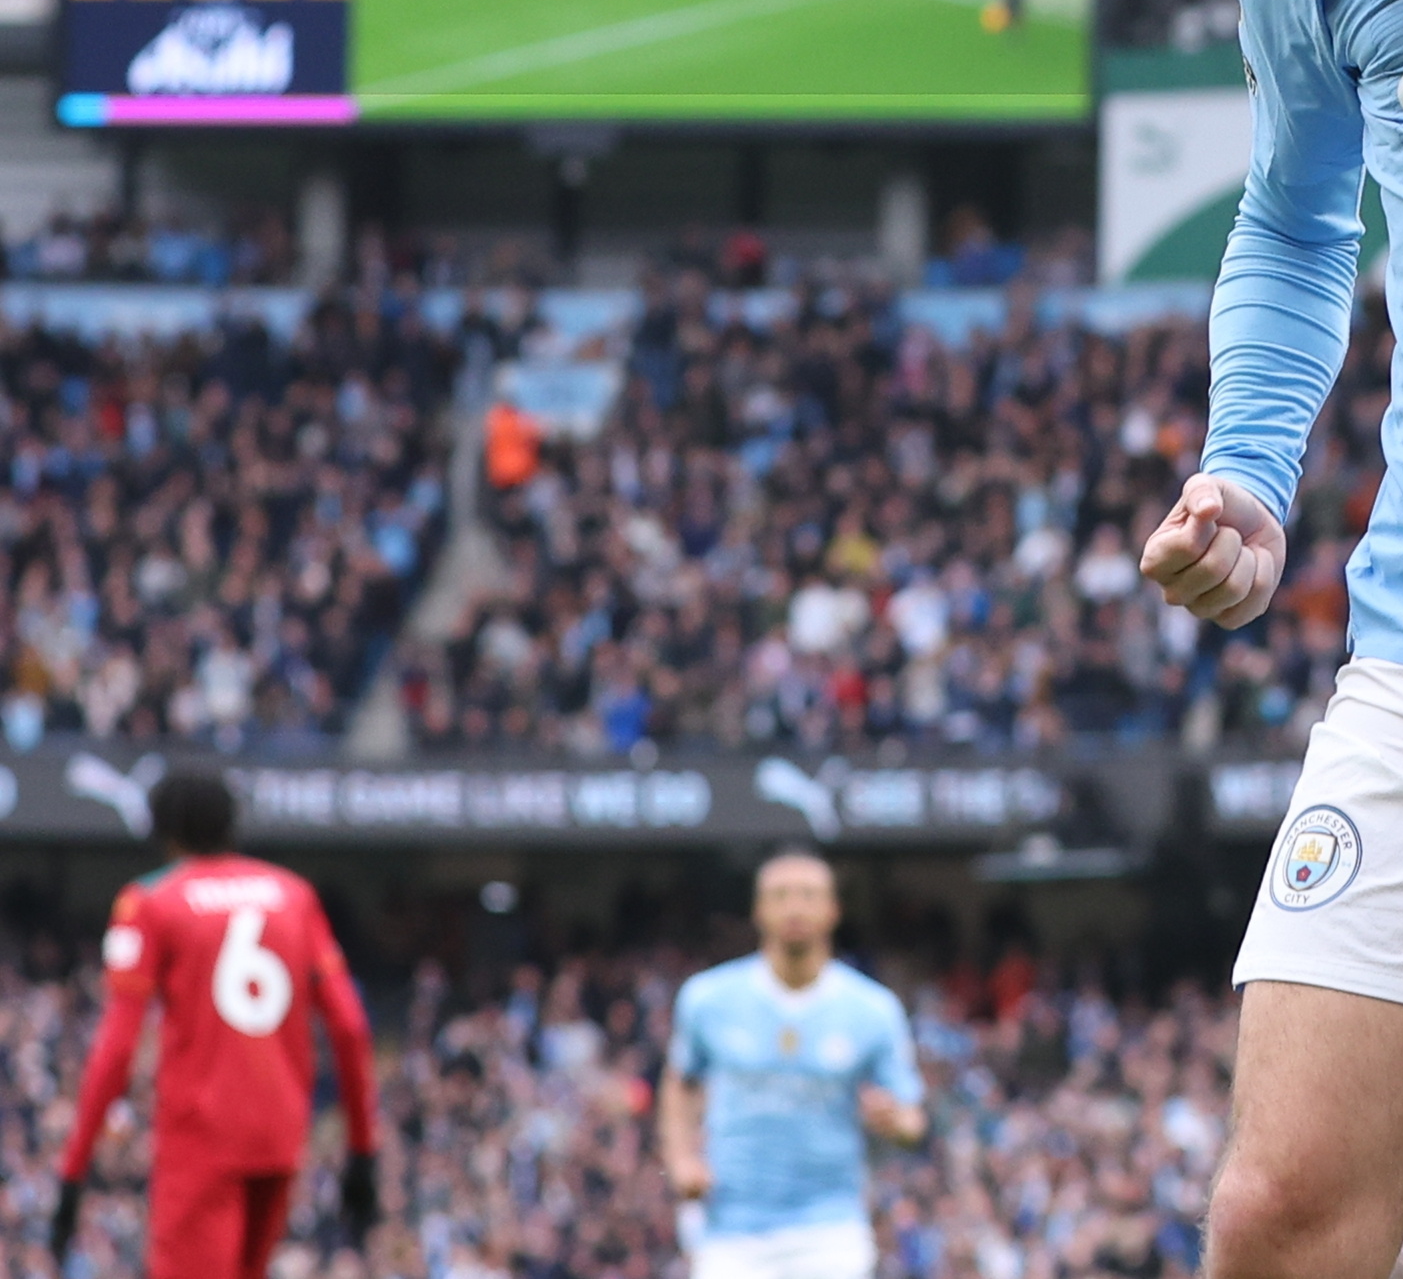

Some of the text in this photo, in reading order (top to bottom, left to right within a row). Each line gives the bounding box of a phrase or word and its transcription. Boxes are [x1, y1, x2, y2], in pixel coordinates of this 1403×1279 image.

[1286, 813, 1352, 850] MANCHESTER
[1283, 893, 1311, 905] CITY
[211, 907, 294, 1039] 6
